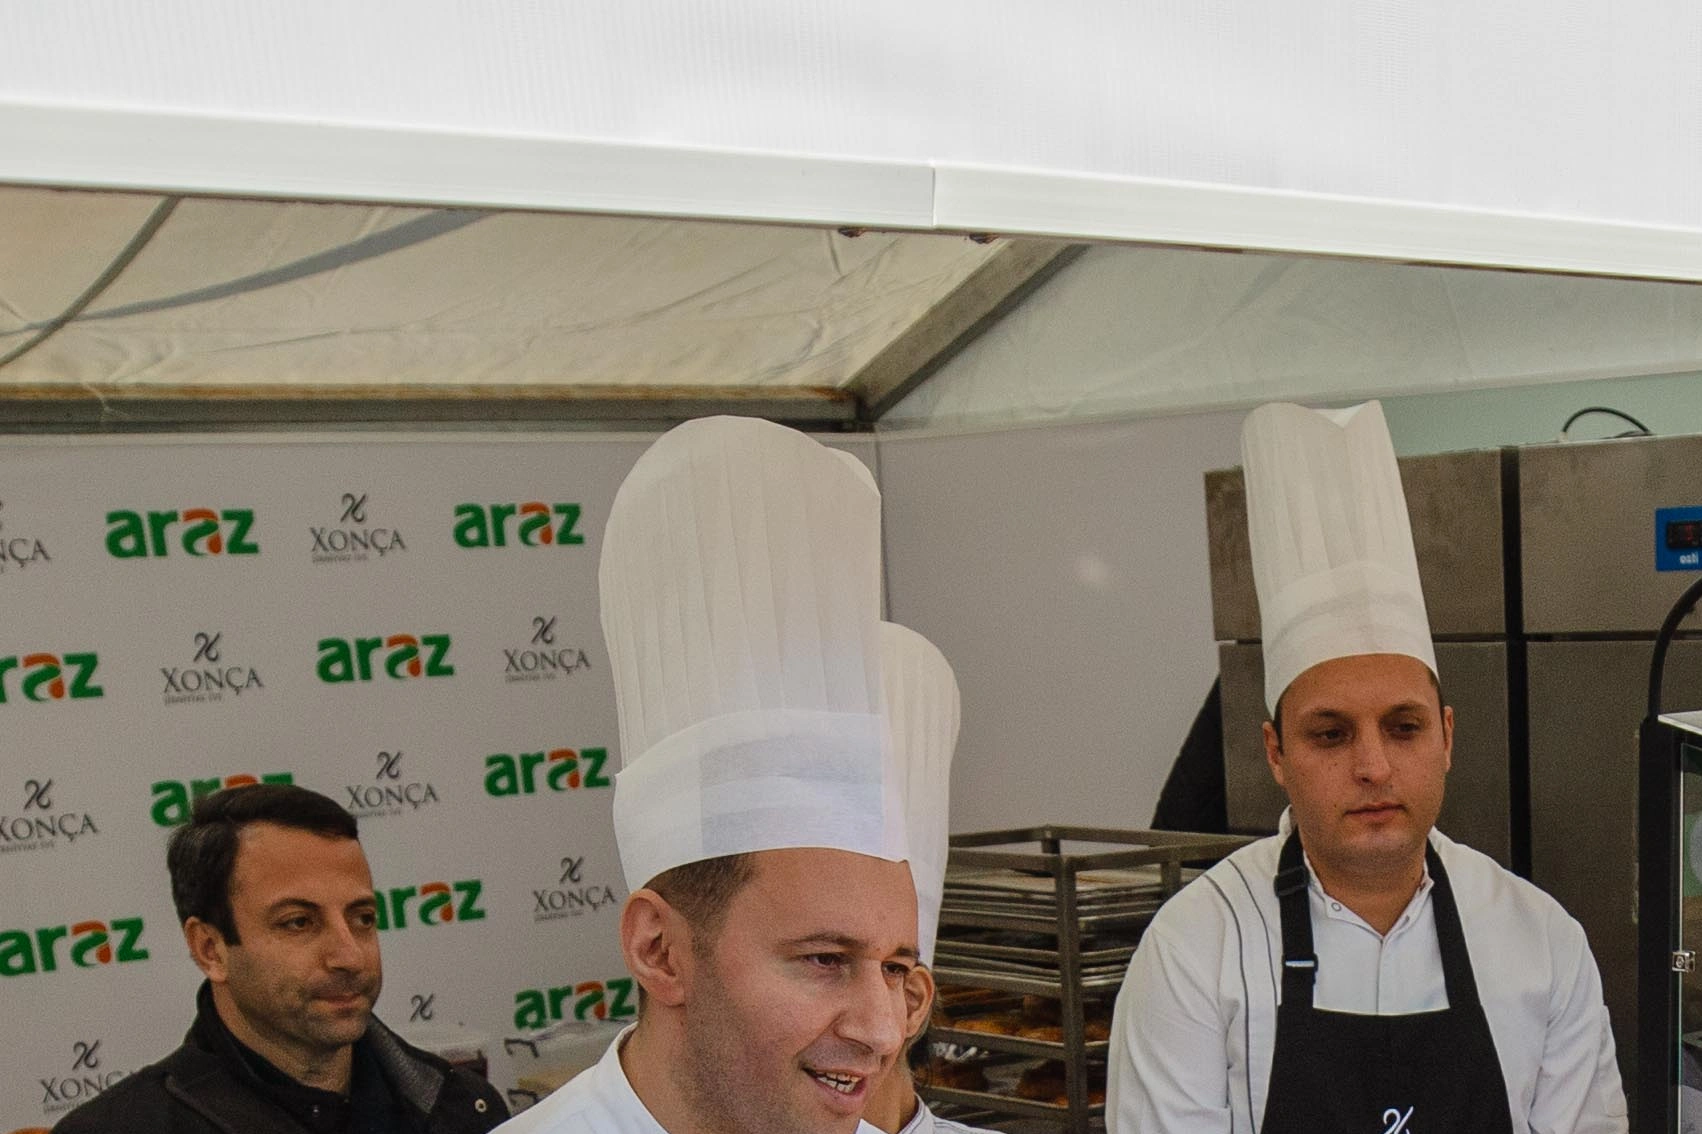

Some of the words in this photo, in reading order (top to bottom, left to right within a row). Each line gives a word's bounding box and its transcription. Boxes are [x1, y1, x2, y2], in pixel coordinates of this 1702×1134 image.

[105, 508, 259, 558] araz
[310, 527, 406, 557] XONÇA
[453, 502, 585, 547] araz
[315, 634, 455, 683] araz
[504, 649, 591, 675] XONÇA
[160, 667, 264, 696] XONÇA
[484, 747, 611, 797] araz
[346, 782, 439, 811] XONÇA
[532, 885, 617, 911] XONÇA
[0, 917, 149, 976] araz
[513, 977, 636, 1031] araz
[40, 1070, 133, 1103] XON
